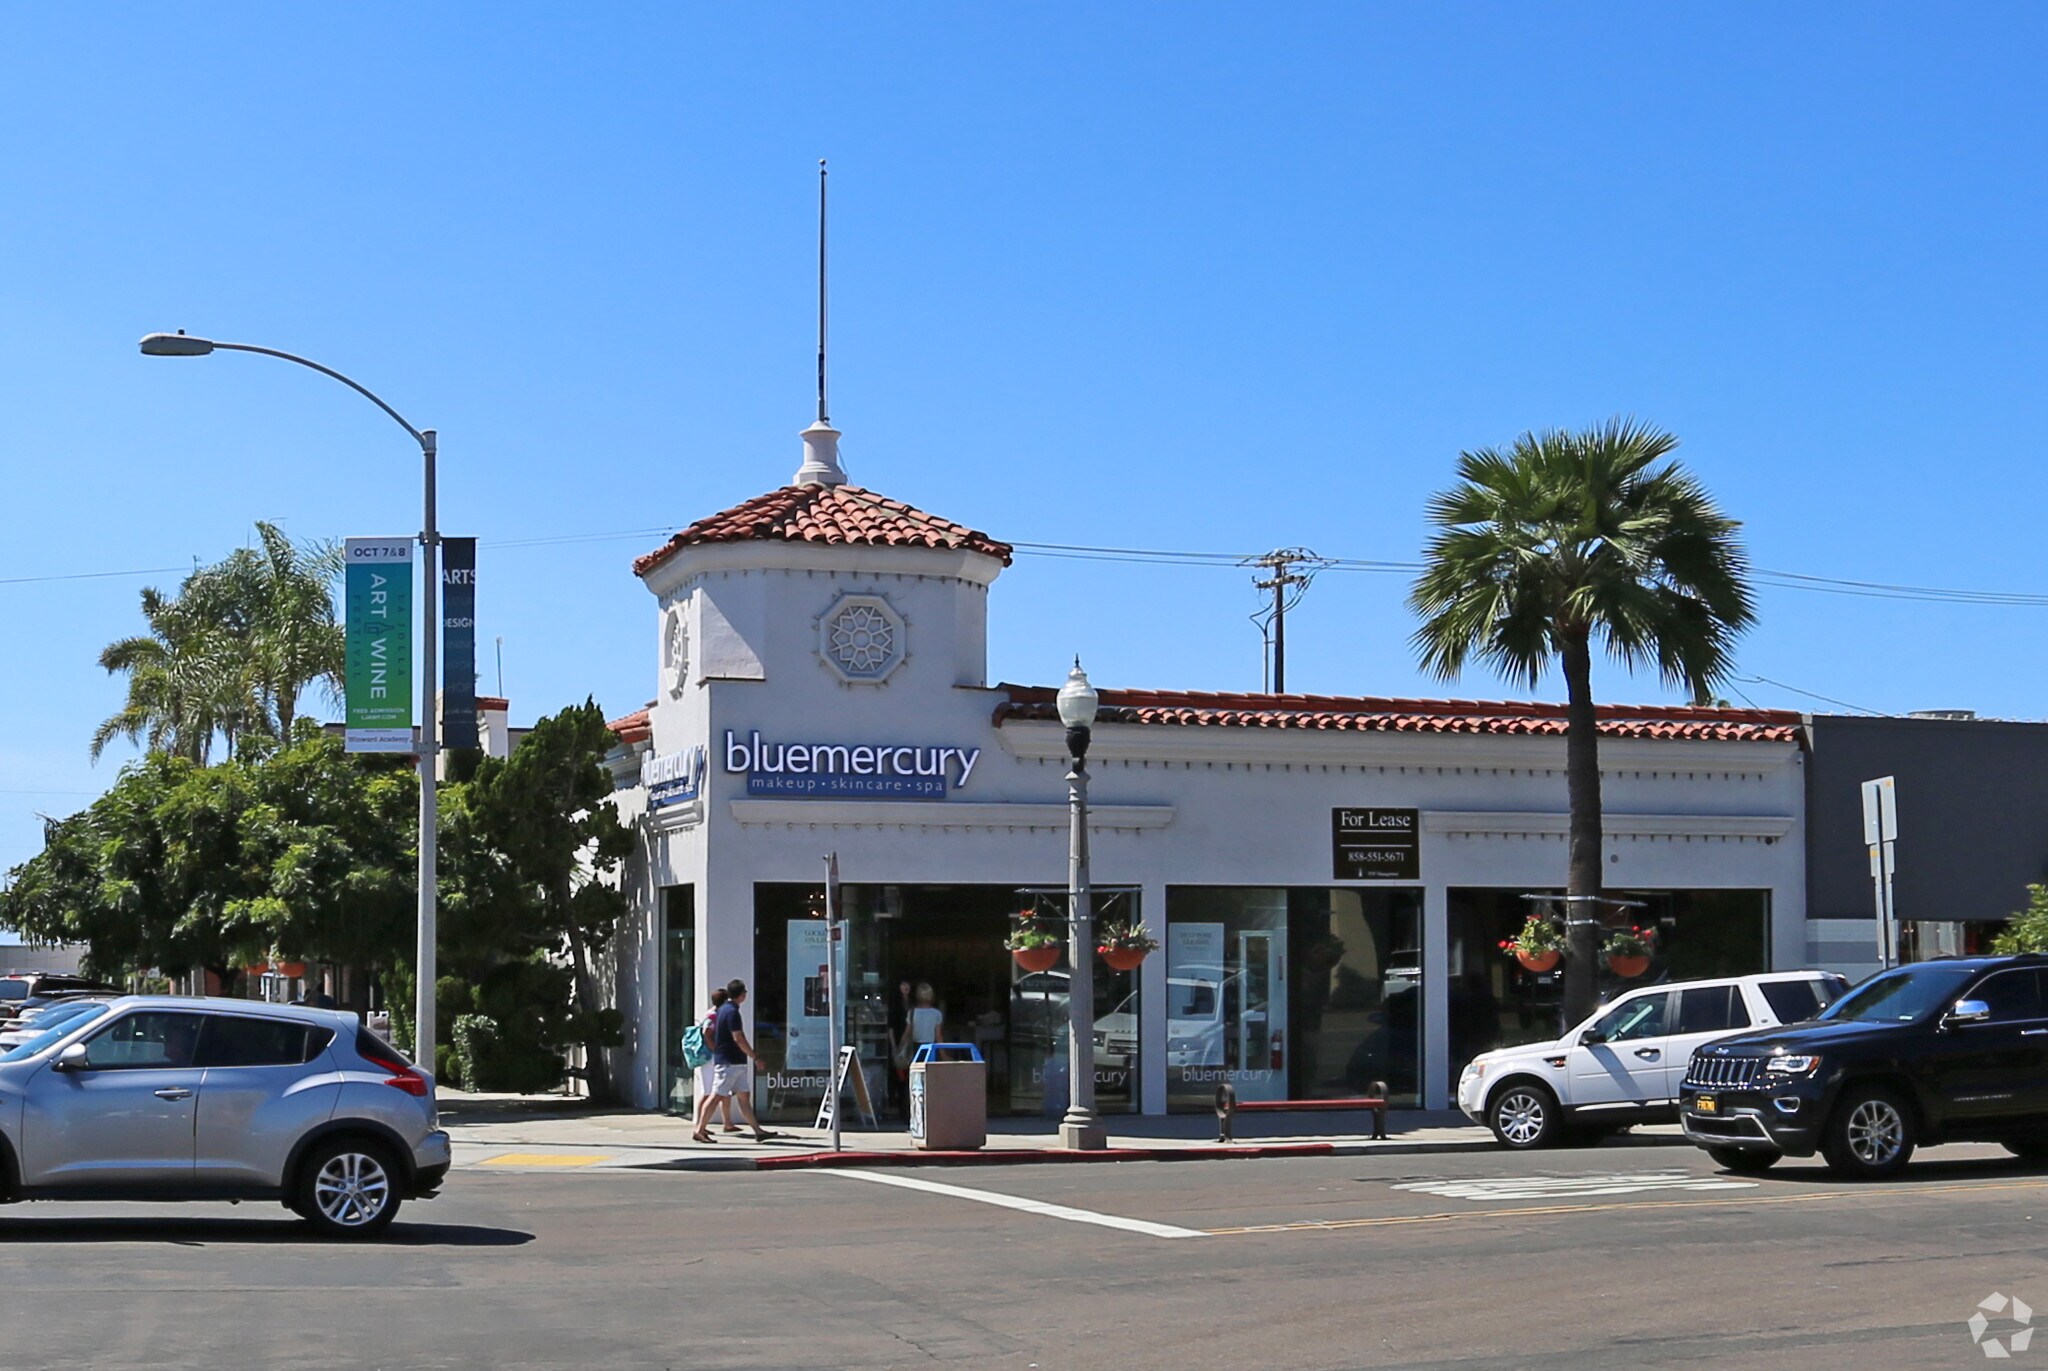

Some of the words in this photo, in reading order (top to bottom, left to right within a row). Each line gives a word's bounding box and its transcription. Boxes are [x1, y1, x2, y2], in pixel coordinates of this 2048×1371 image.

[353, 547, 379, 557] OCT
[370, 573, 387, 619] ART
[397, 593, 406, 613] LA
[353, 593, 361, 679] FESTIVAL
[370, 637, 387, 699] WINE
[725, 731, 980, 788] bluemercury
[752, 776, 816, 790] makeup
[831, 778, 902, 792] skincare
[917, 781, 943, 793] spa
[1341, 811, 1363, 826] For
[1369, 811, 1410, 827] Lease
[1182, 1067, 1273, 1084] bluemercury
